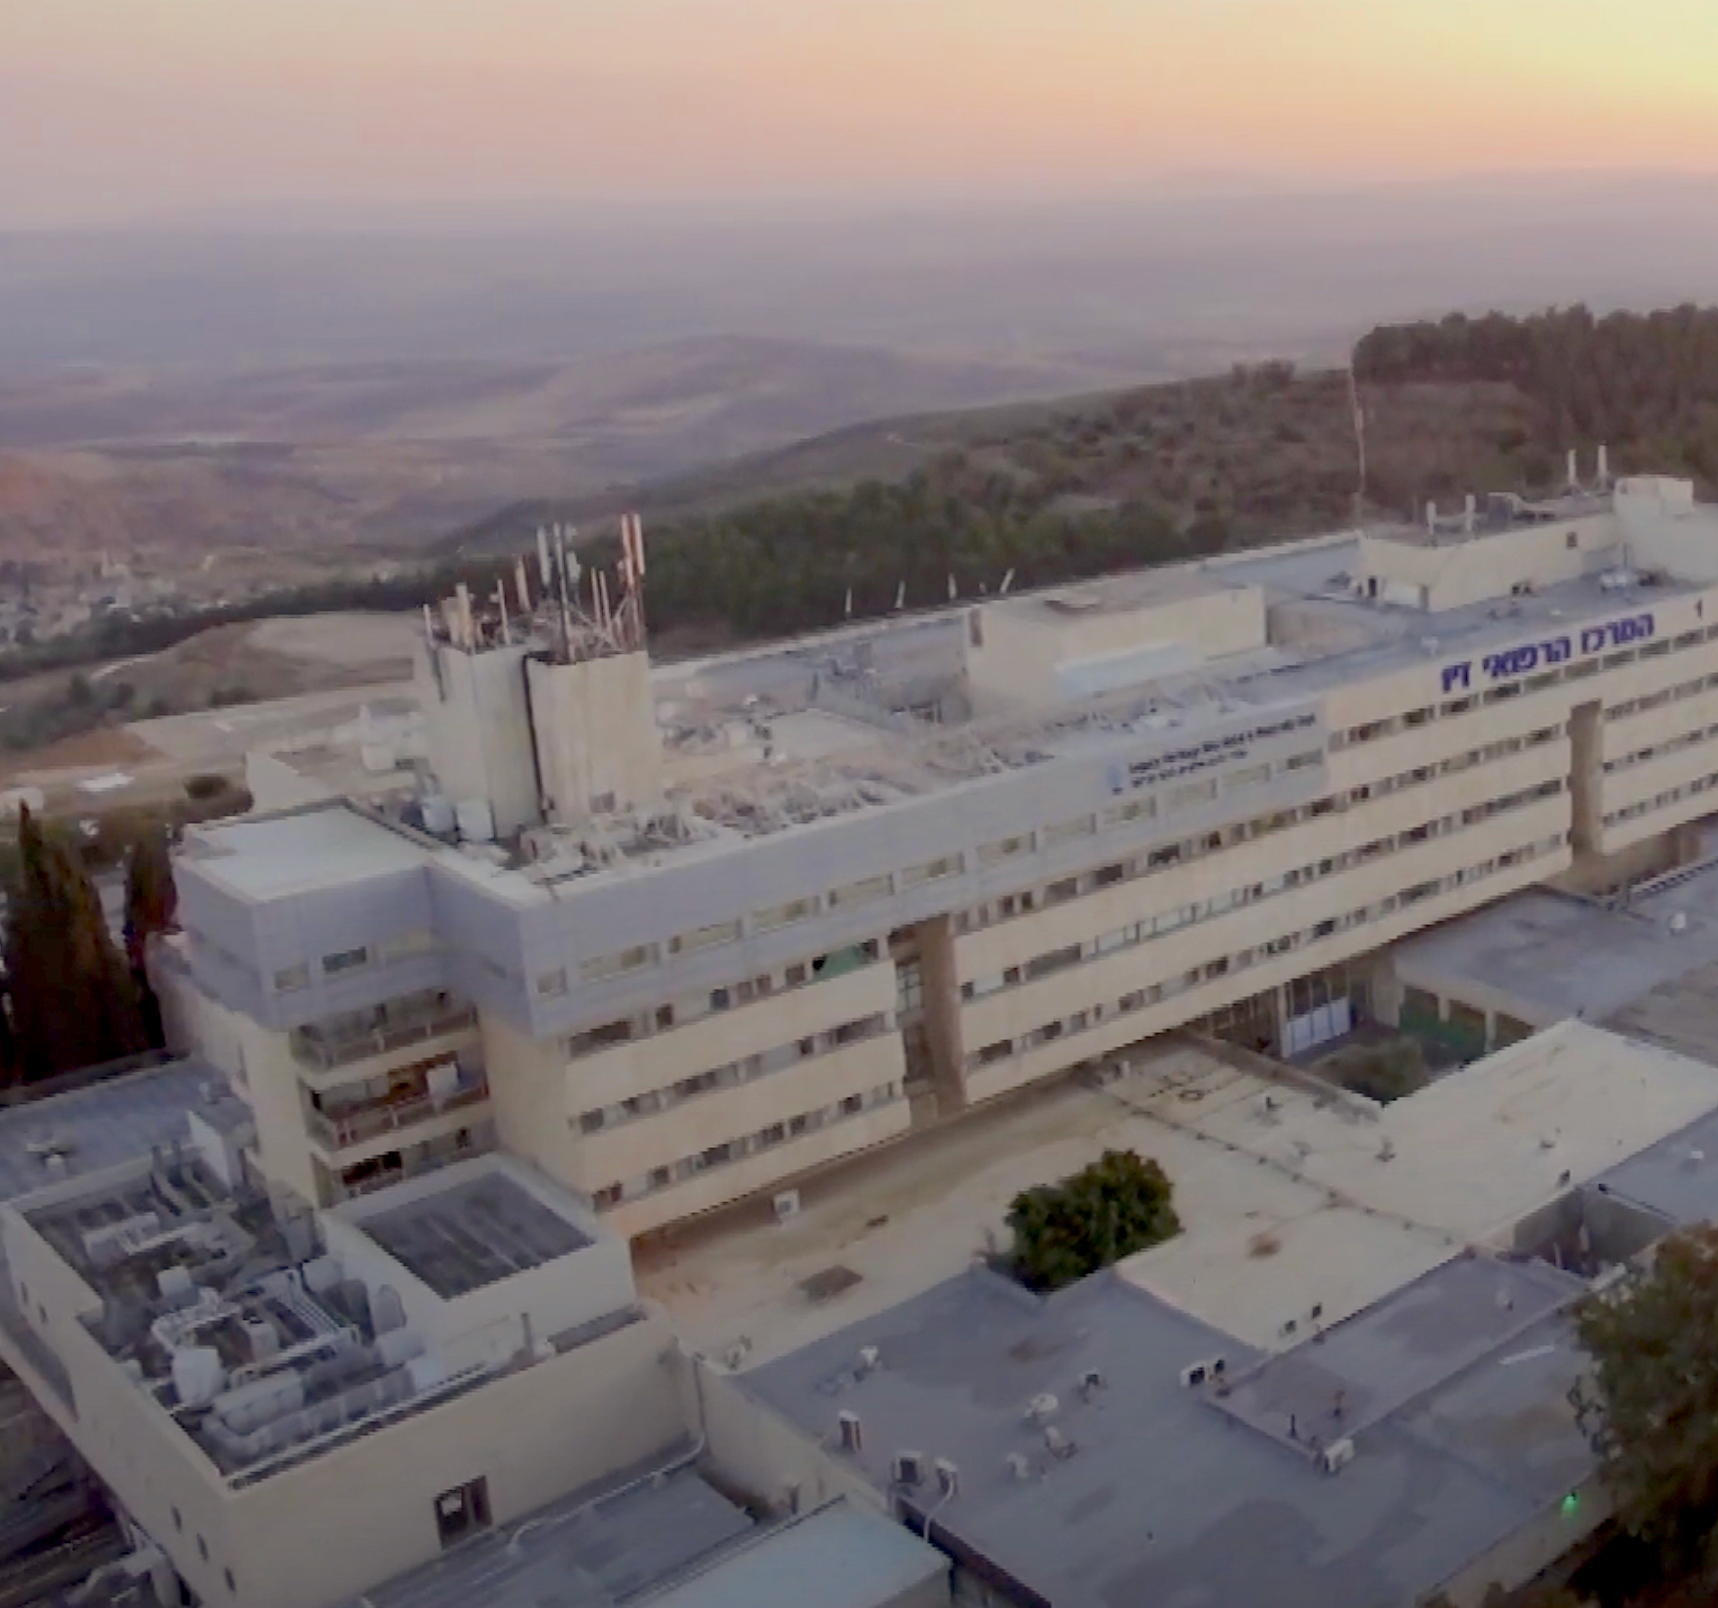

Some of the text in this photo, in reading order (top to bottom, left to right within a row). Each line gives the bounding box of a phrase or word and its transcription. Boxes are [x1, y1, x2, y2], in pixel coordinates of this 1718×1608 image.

[1441, 613, 1655, 694] המרכז הרפואי זיו
